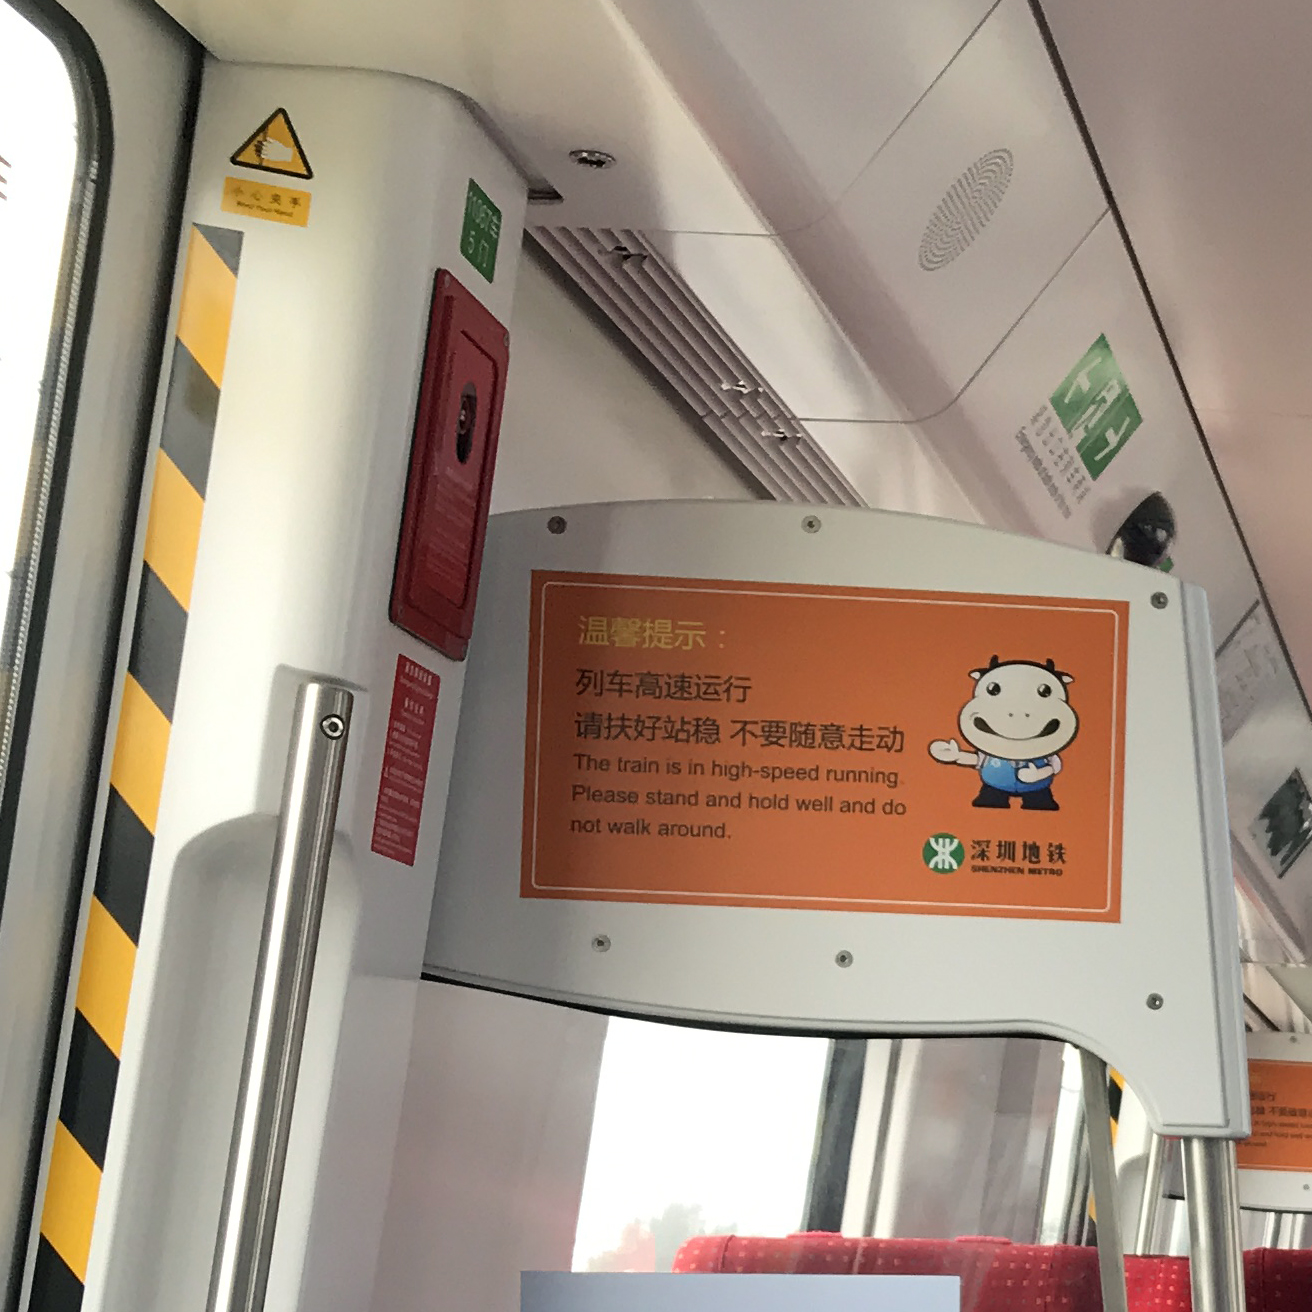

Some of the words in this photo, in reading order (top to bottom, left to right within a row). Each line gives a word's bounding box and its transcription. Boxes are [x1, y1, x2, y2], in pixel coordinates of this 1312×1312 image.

[575, 668, 752, 703] 列车高速运行
[574, 711, 721, 745] 请扶好站稳
[730, 719, 905, 753] 不要随意走动
[573, 753, 611, 771] The
[617, 757, 660, 774] train
[666, 758, 682, 775] is
[688, 759, 705, 775] in
[711, 760, 819, 783] high-speed
[571, 784, 639, 804] Please
[645, 789, 699, 806] stand
[706, 793, 741, 808] and
[748, 793, 789, 810] hold
[795, 796, 833, 812] well
[839, 798, 876, 814] and
[882, 799, 907, 816] do
[570, 818, 601, 833] not
[607, 819, 651, 835] walk
[657, 823, 732, 839] around.
[970, 840, 1067, 864] 深圳地铁
